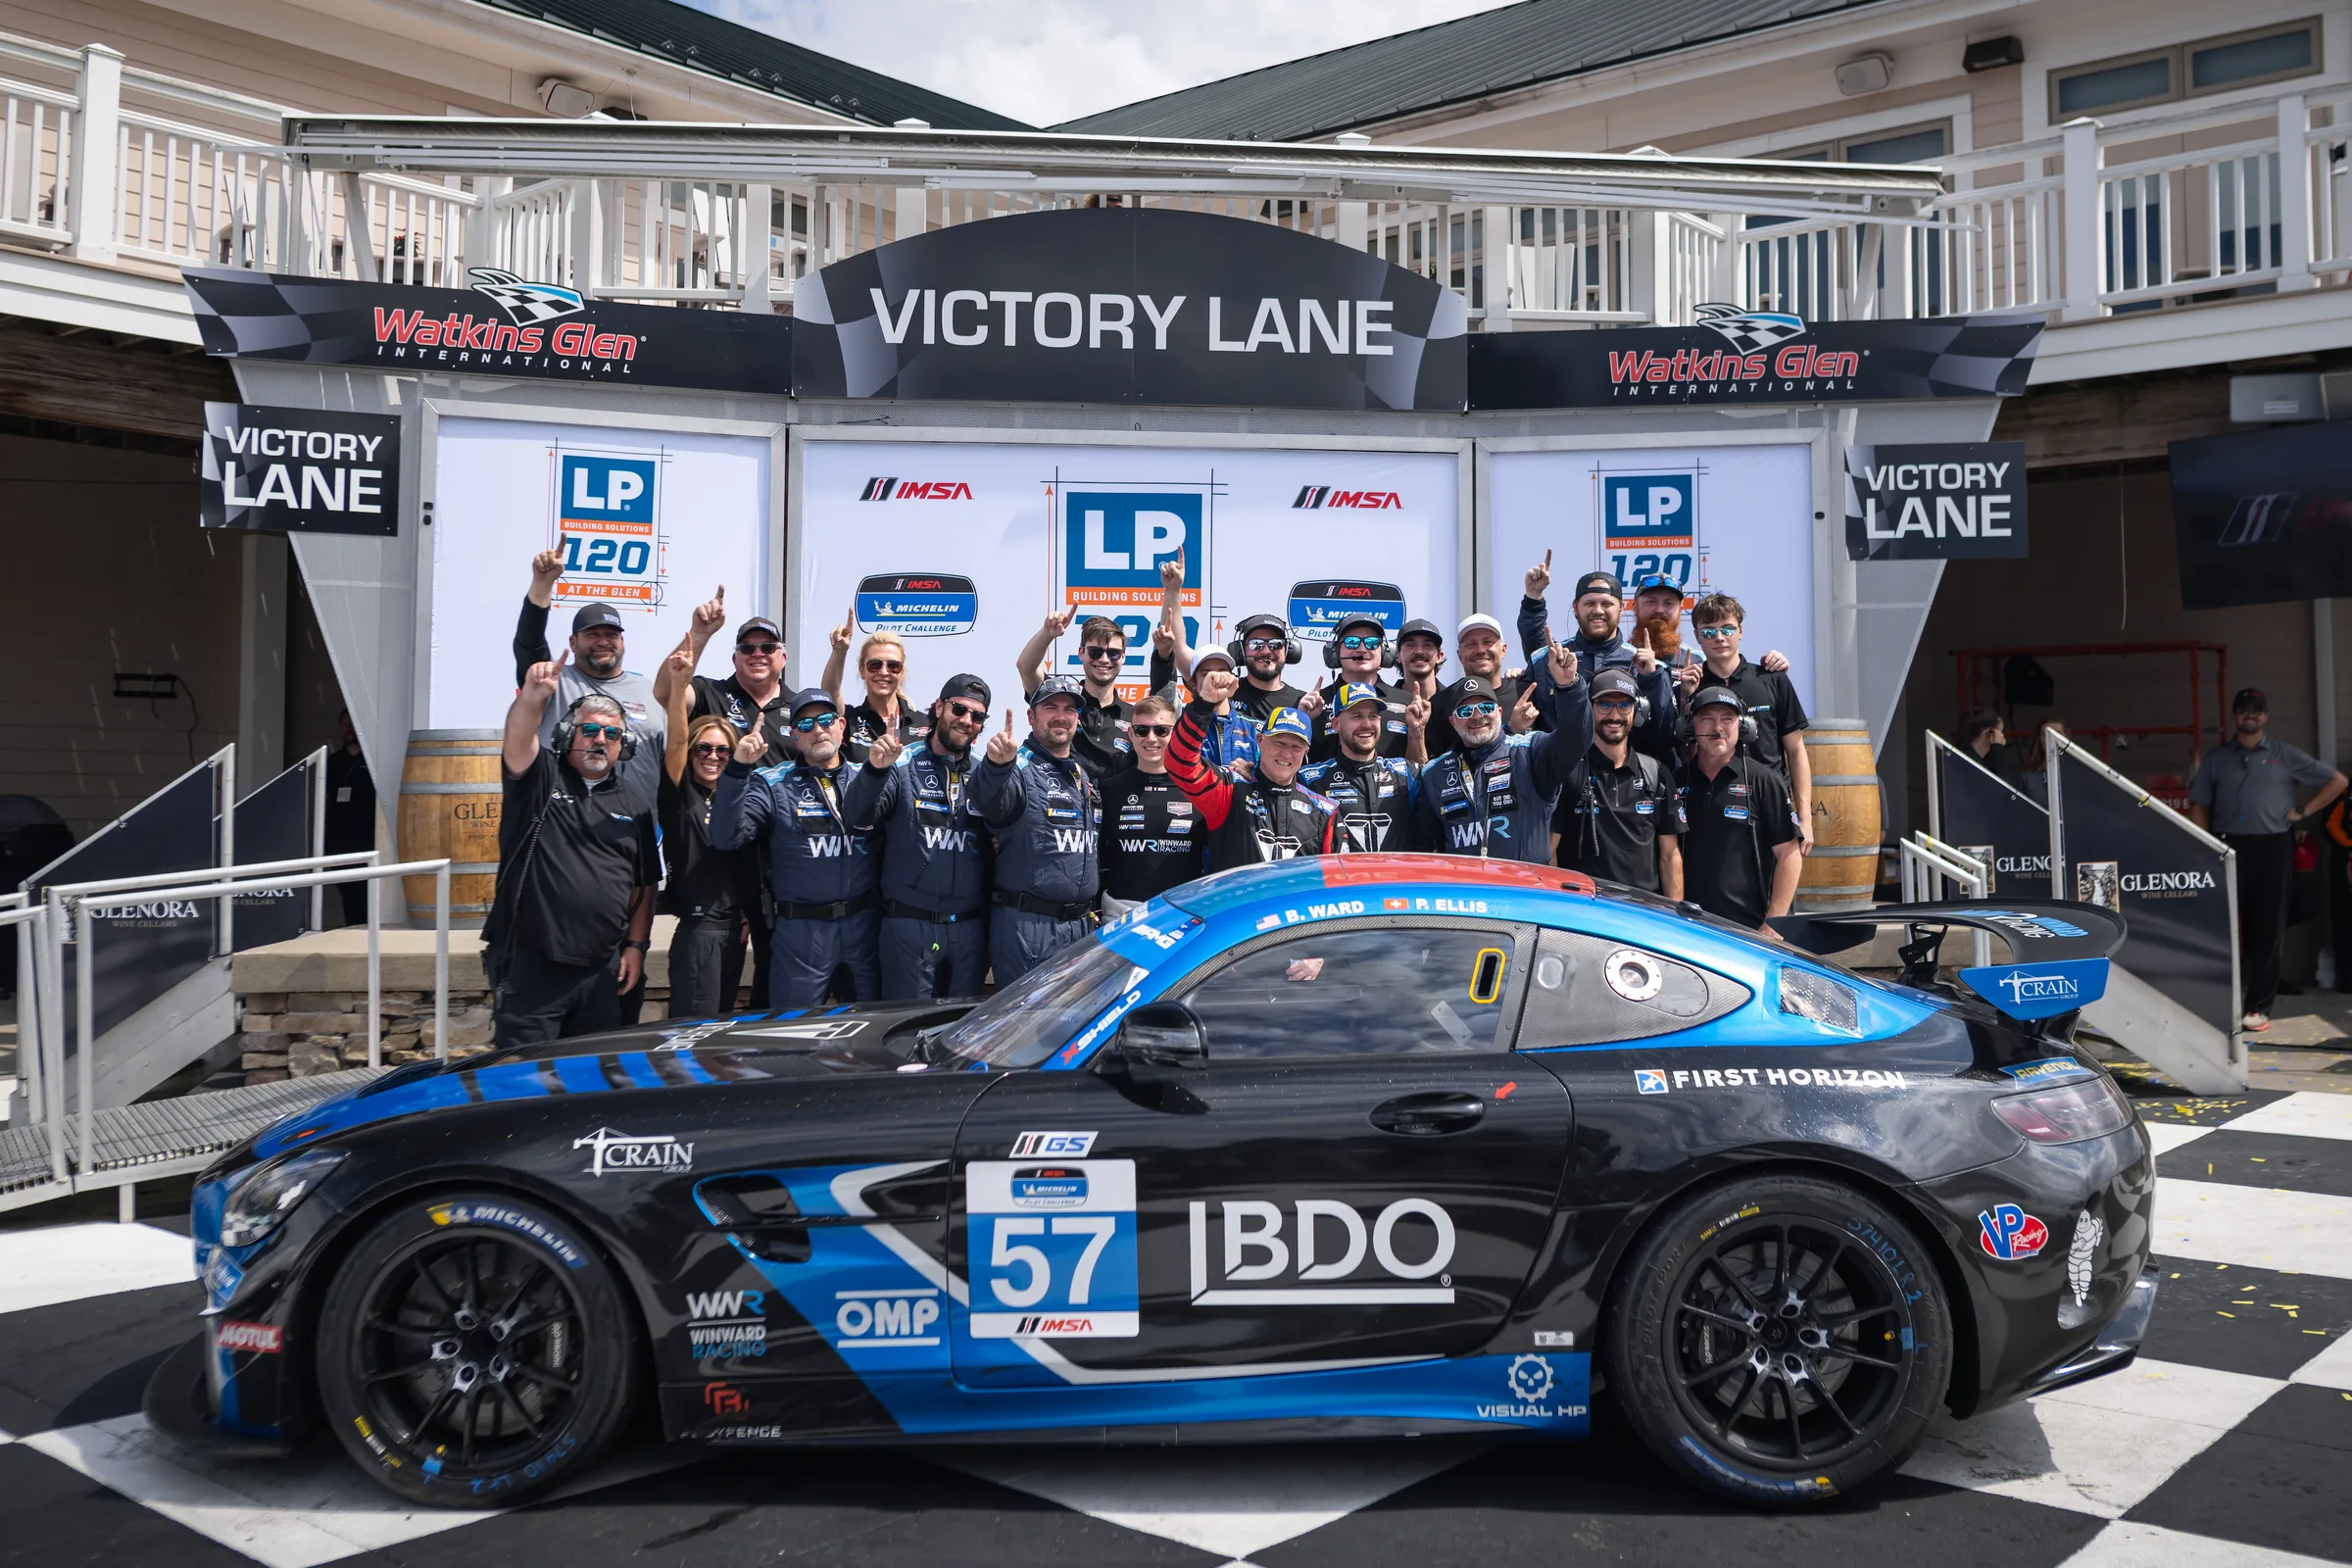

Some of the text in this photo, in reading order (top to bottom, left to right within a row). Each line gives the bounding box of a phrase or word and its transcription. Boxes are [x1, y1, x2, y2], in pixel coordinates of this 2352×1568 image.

[869, 288, 1395, 356] VICTORY LANE
[373, 307, 637, 361] Watkins Glen
[377, 346, 631, 374] INTERNATIONAL
[1608, 345, 1858, 384] Watkins Glen
[1613, 378, 1854, 396] INTERNATIONAL
[224, 425, 383, 463] VICTORY
[1864, 462, 2011, 492] VICTORY
[223, 463, 383, 514] LANE
[573, 467, 644, 510] LP
[896, 482, 973, 500] IMSA
[1328, 491, 1402, 509] IMSA
[1616, 486, 1682, 526] LP
[564, 521, 650, 533] BUILDING SOLUTIONS
[1865, 494, 2012, 539] LANE
[1084, 510, 1186, 570] LP
[564, 537, 651, 575] 120
[567, 585, 641, 598] AT THE GLEN
[907, 580, 942, 589] IMSA
[1338, 588, 1372, 597] IMSA
[1073, 591, 1197, 602] BUILDING SOLUNS
[905, 623, 957, 632] CHALLENGE
[2121, 871, 2217, 892] GLENORA
[2163, 890, 2199, 899] CELLARS
[1285, 901, 1365, 924] B. WARD
[1415, 898, 1488, 913] P. ELLIS
[137, 919, 178, 928] CELLARS
[2021, 980, 2079, 997] CRAIN
[1675, 1068, 1907, 1090] FIRST HORIZON
[2015, 1059, 2081, 1080] RAVENOL
[605, 1142, 696, 1167] CRAIN
[1045, 1137, 1089, 1152] GS
[662, 1162, 694, 1174] GROUP
[1036, 1184, 1078, 1193] MICHELIN
[472, 1205, 578, 1262] MICHELIN
[1221, 1198, 1456, 1281] BDO
[1978, 1203, 2026, 1259] VP
[2013, 1227, 2047, 1251] Racing
[990, 1215, 1117, 1308] 57
[836, 1298, 941, 1338] OMP
[1040, 1318, 1094, 1334] IMSA
[219, 1324, 278, 1349] MOTUL
[689, 1325, 766, 1345] WINWARD
[692, 1340, 767, 1360] RACING
[1477, 1404, 1587, 1418] VISUAL HP
